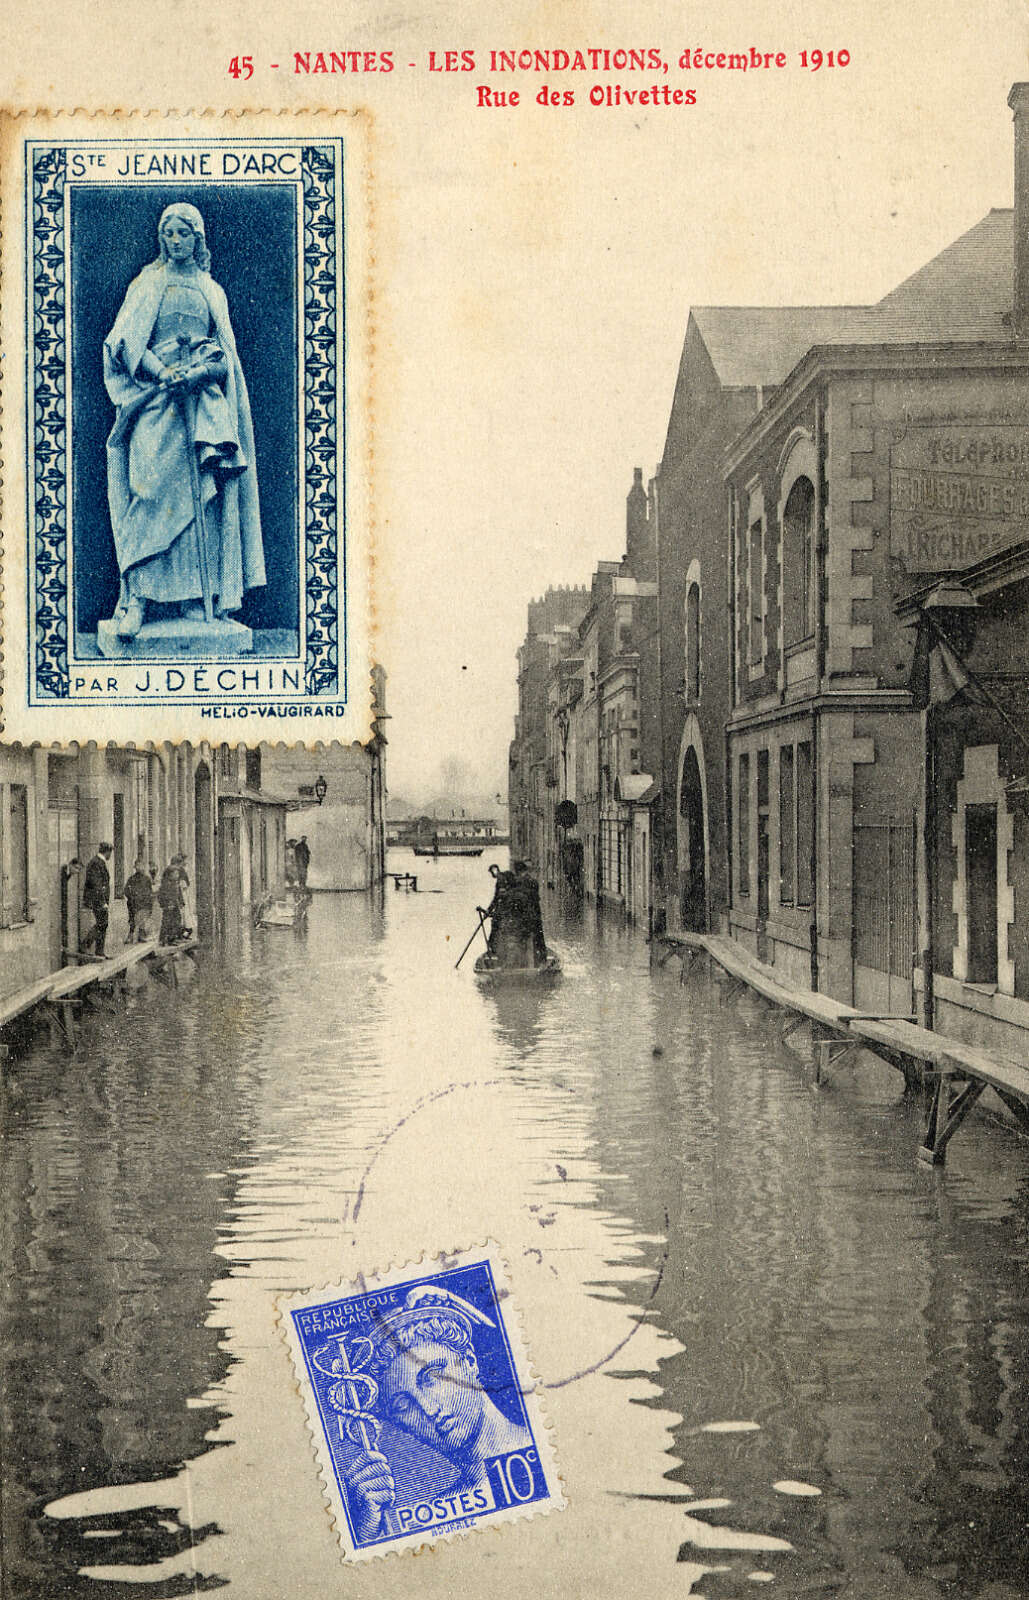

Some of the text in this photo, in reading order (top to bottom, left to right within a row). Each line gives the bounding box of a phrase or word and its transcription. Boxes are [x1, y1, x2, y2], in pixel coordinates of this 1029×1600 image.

[117, 153, 212, 176] JEANNE
[222, 152, 298, 176] D'ARC
[74, 675, 119, 692] PAR
[300, 1292, 399, 1326] REPUBLIQUE
[398, 1489, 488, 1528] POSTES
